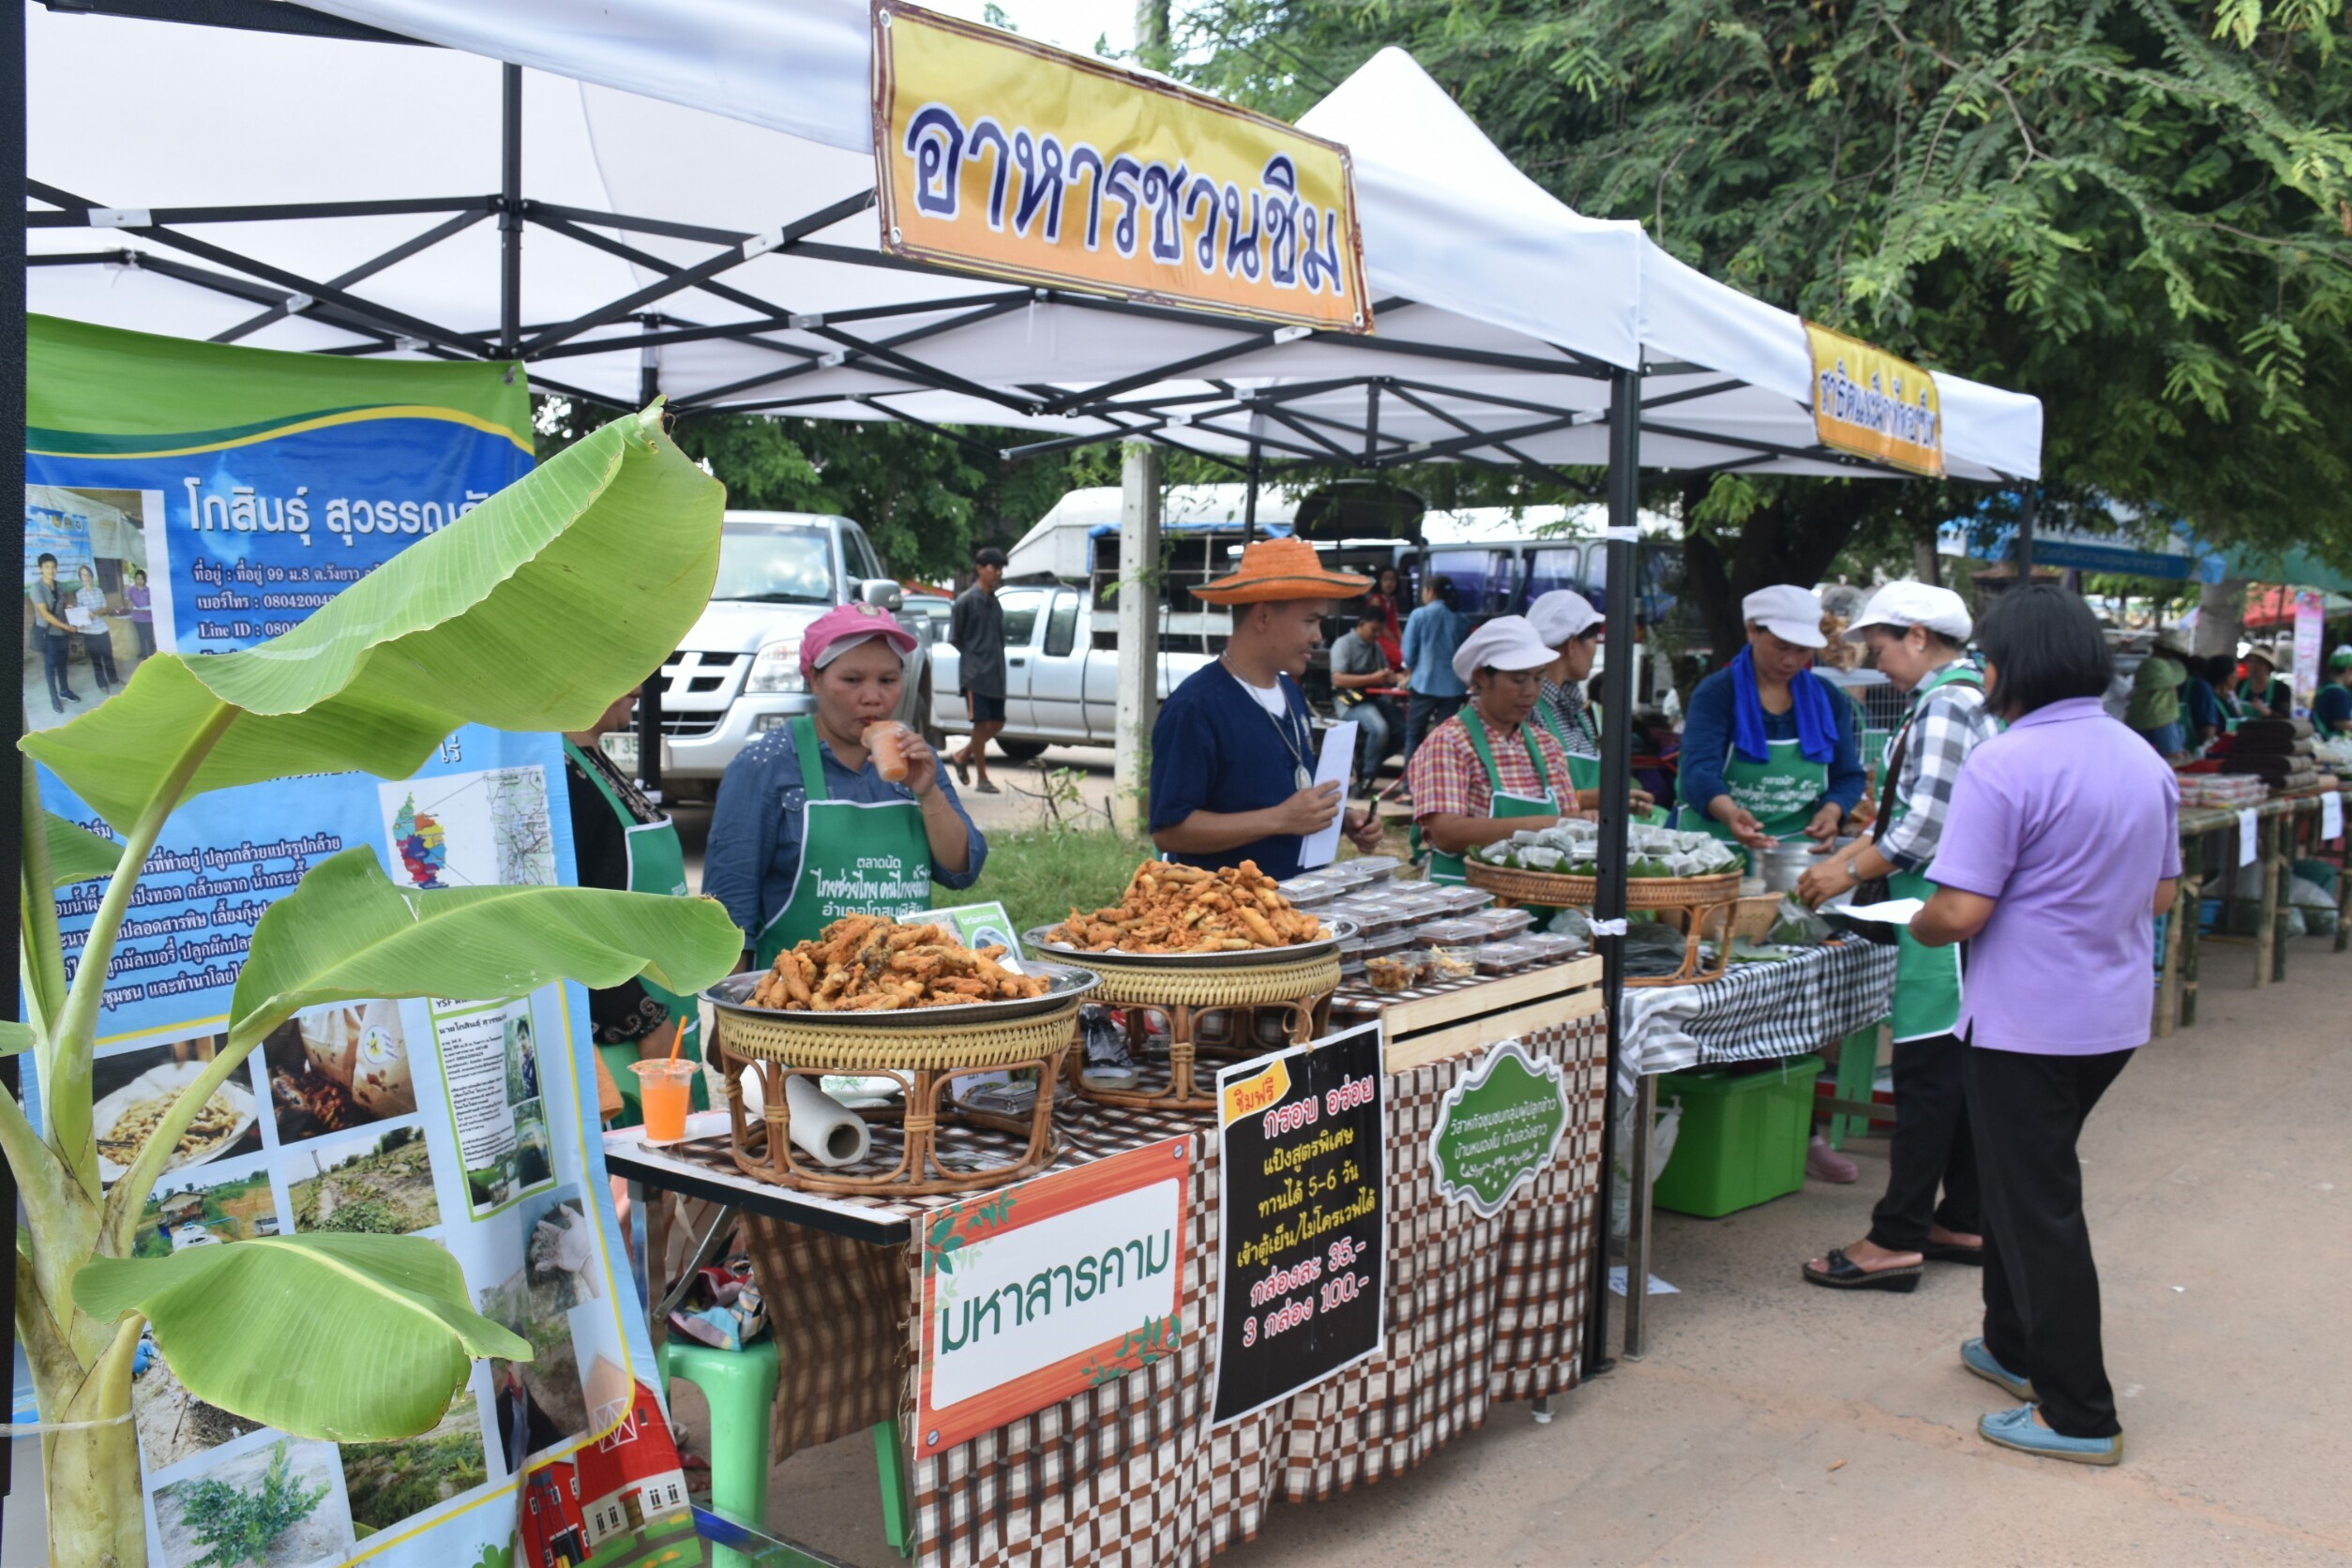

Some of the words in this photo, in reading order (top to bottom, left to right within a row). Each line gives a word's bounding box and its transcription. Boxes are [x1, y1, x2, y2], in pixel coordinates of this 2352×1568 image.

[903, 101, 1345, 296] อาหารชวนชิม
[184, 476, 312, 547] โกสินธุ์
[193, 560, 221, 584] ที่อยู่
[236, 559, 263, 584] ที่อยู่
[267, 567, 284, 580] 99
[289, 568, 309, 580] ม.8
[198, 591, 249, 609] เบอร์โทร
[200, 623, 230, 638] Line
[233, 622, 251, 637] ID
[188, 878, 248, 898] กล้วยตาก
[856, 854, 902, 869] ตลาดนัด
[1233, 1076, 1274, 1113] ชิมฟรี
[1263, 1095, 1319, 1139] กรอบ
[1325, 1074, 1376, 1117] อร่อย
[1263, 1127, 1354, 1175] แป้งสูตรพิเศษ
[1259, 1177, 1304, 1218] ทานได้
[1308, 1168, 1337, 1198] 5-6
[1342, 1159, 1360, 1184] วัน
[941, 1229, 1170, 1355] มหาสารคาม
[1250, 1256, 1322, 1308] กล่องละ
[1328, 1235, 1367, 1272] 35.-
[1243, 1315, 1258, 1348] 3
[1264, 1296, 1314, 1339] กล่อง
[1319, 1271, 1370, 1313] 100.-
